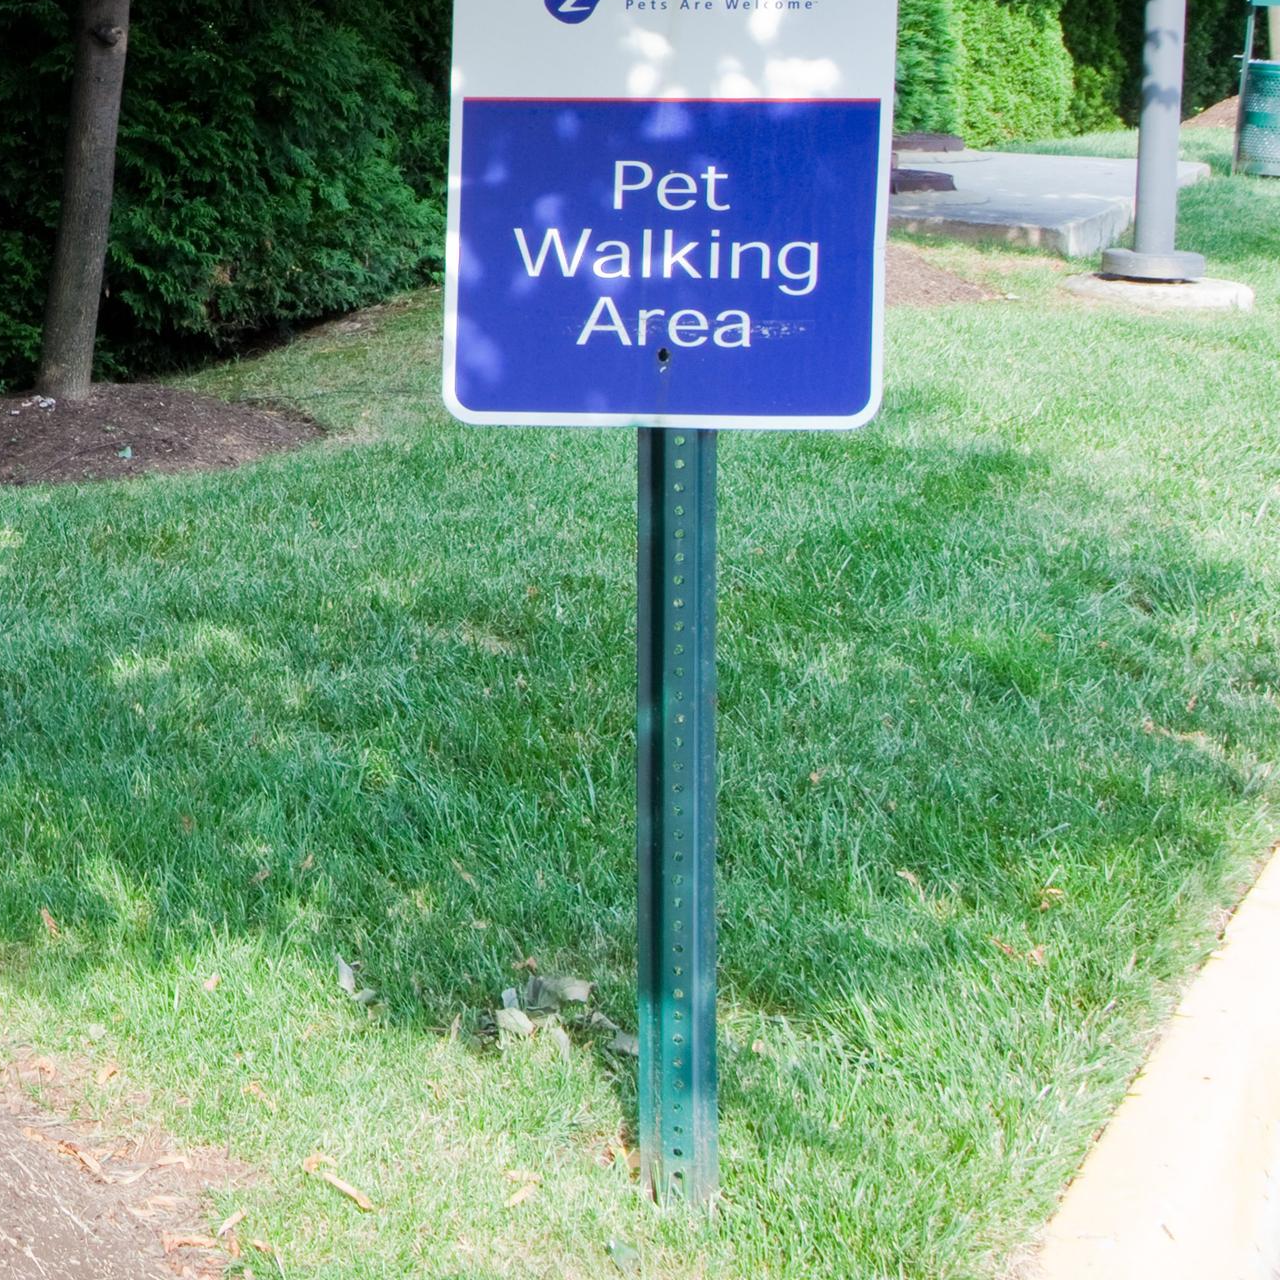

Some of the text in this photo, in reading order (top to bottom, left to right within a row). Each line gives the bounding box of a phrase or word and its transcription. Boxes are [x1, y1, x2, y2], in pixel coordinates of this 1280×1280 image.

[613, 160, 731, 211] Pet
[513, 227, 819, 296] Walking
[576, 296, 752, 348] Area
